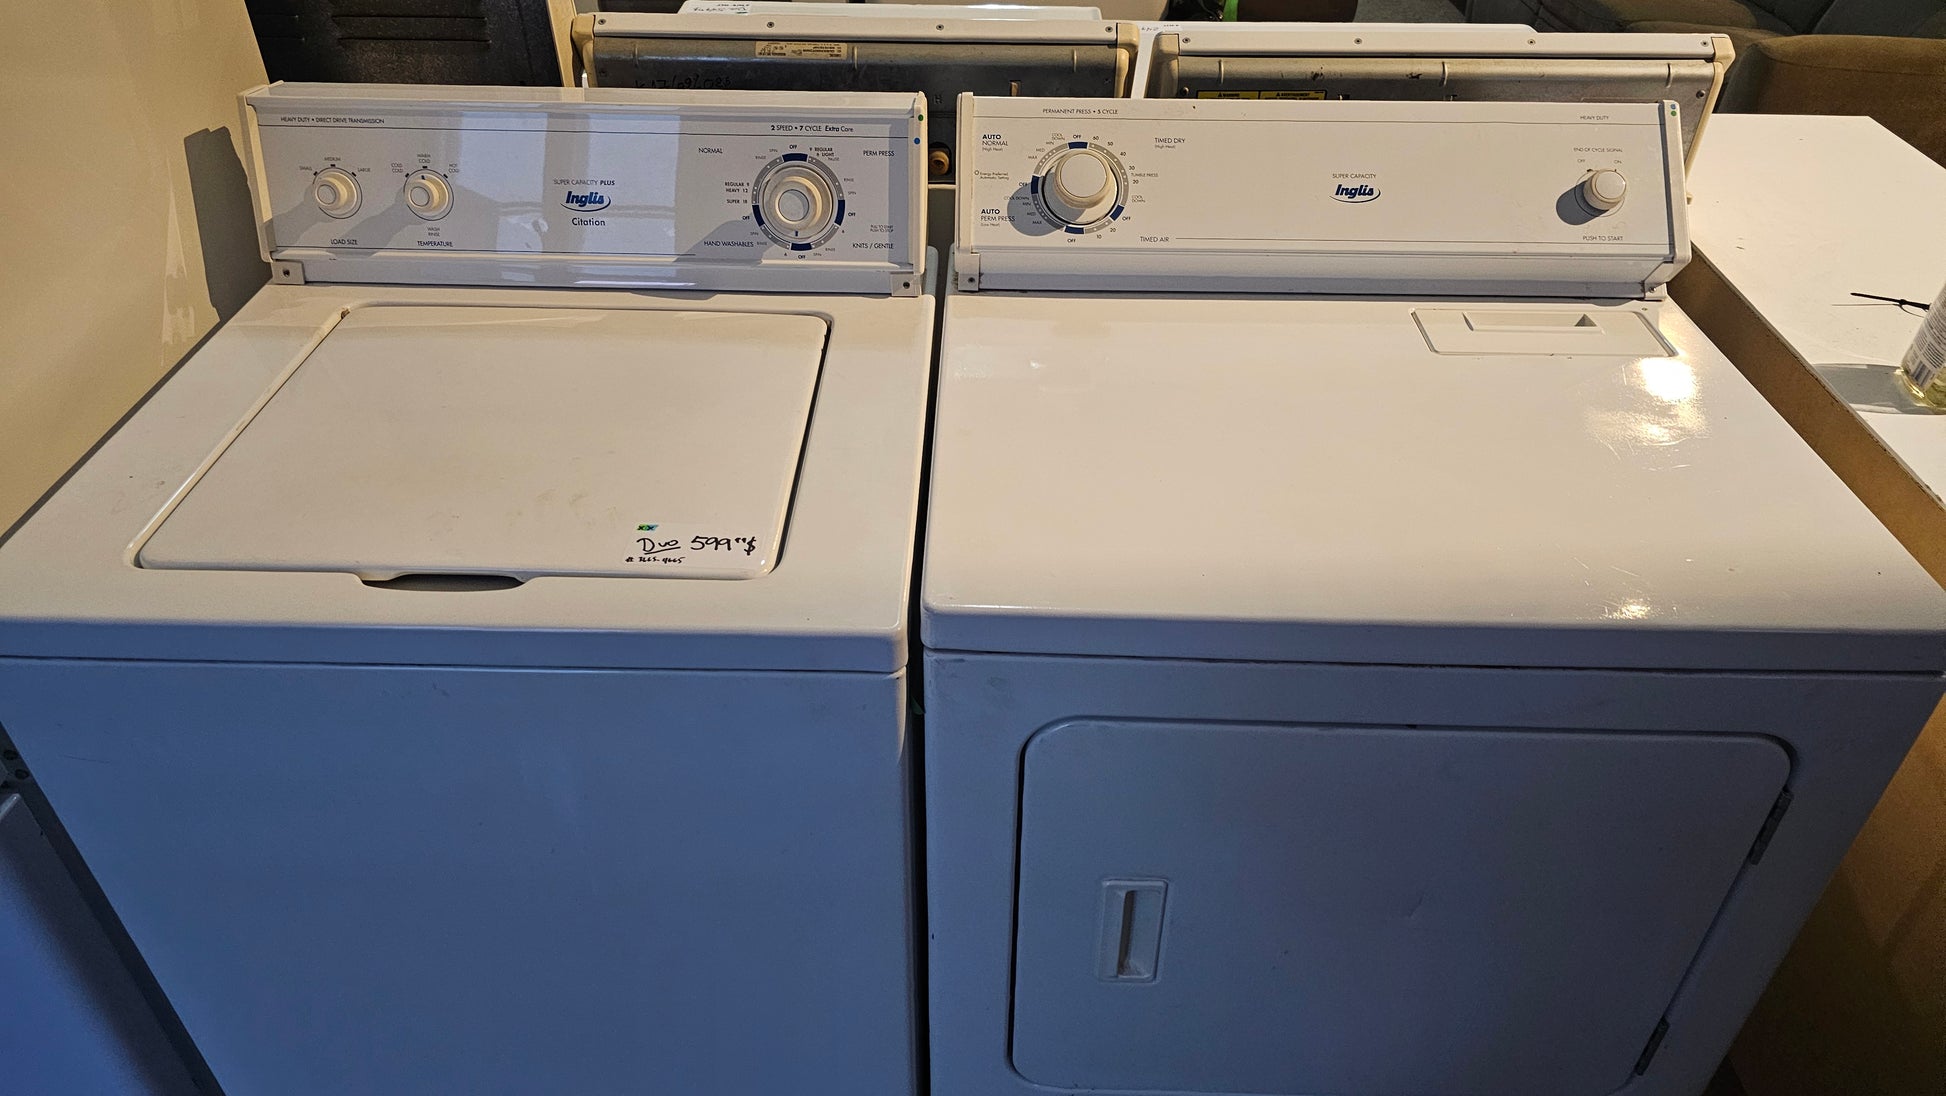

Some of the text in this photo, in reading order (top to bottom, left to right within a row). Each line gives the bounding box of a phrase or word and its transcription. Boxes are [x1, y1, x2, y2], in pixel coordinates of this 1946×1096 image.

[565, 190, 605, 208] Inglis
[1335, 184, 1374, 199] Inglis
[571, 217, 606, 226] Citation
[636, 537, 681, 554] Duo
